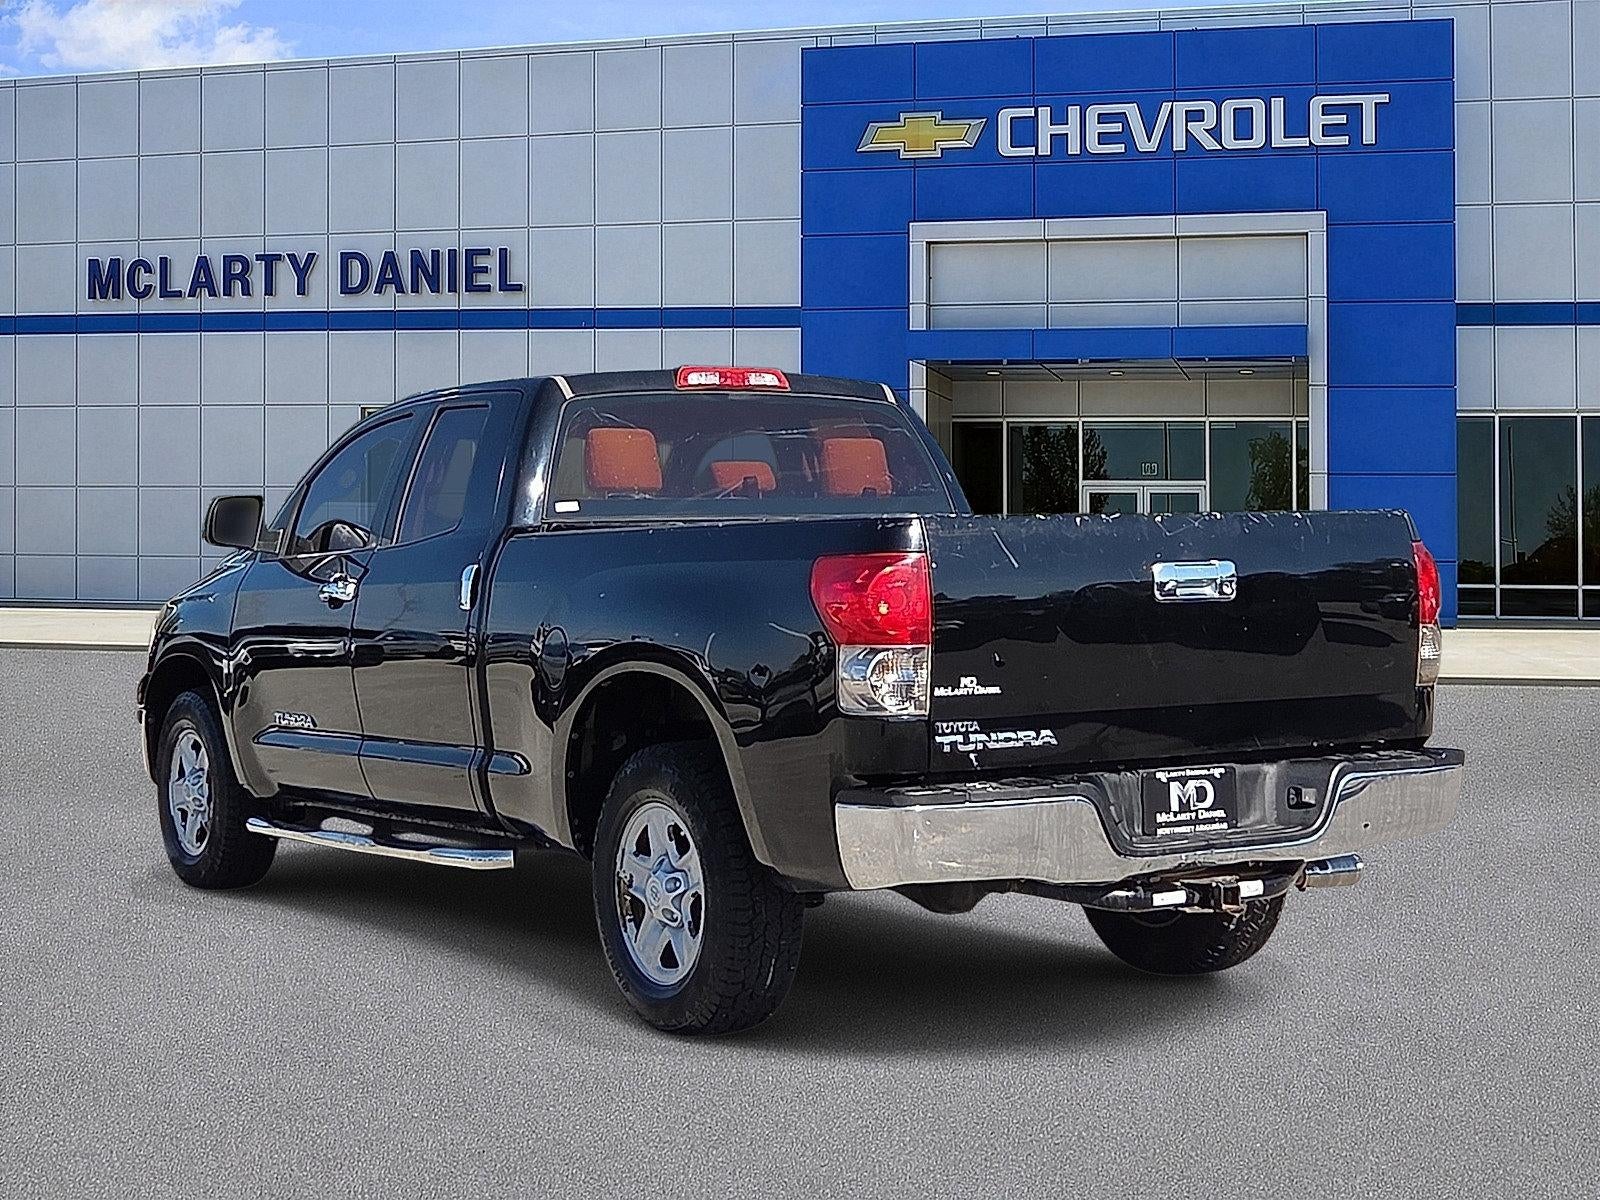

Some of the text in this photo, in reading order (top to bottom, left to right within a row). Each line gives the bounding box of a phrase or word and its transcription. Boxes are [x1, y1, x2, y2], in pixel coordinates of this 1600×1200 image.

[998, 93, 1390, 157] CHEVROLET
[86, 246, 525, 301] MCLARTY DANIEL
[935, 729, 1058, 752] TUNDRA
[1169, 779, 1214, 811] MD
